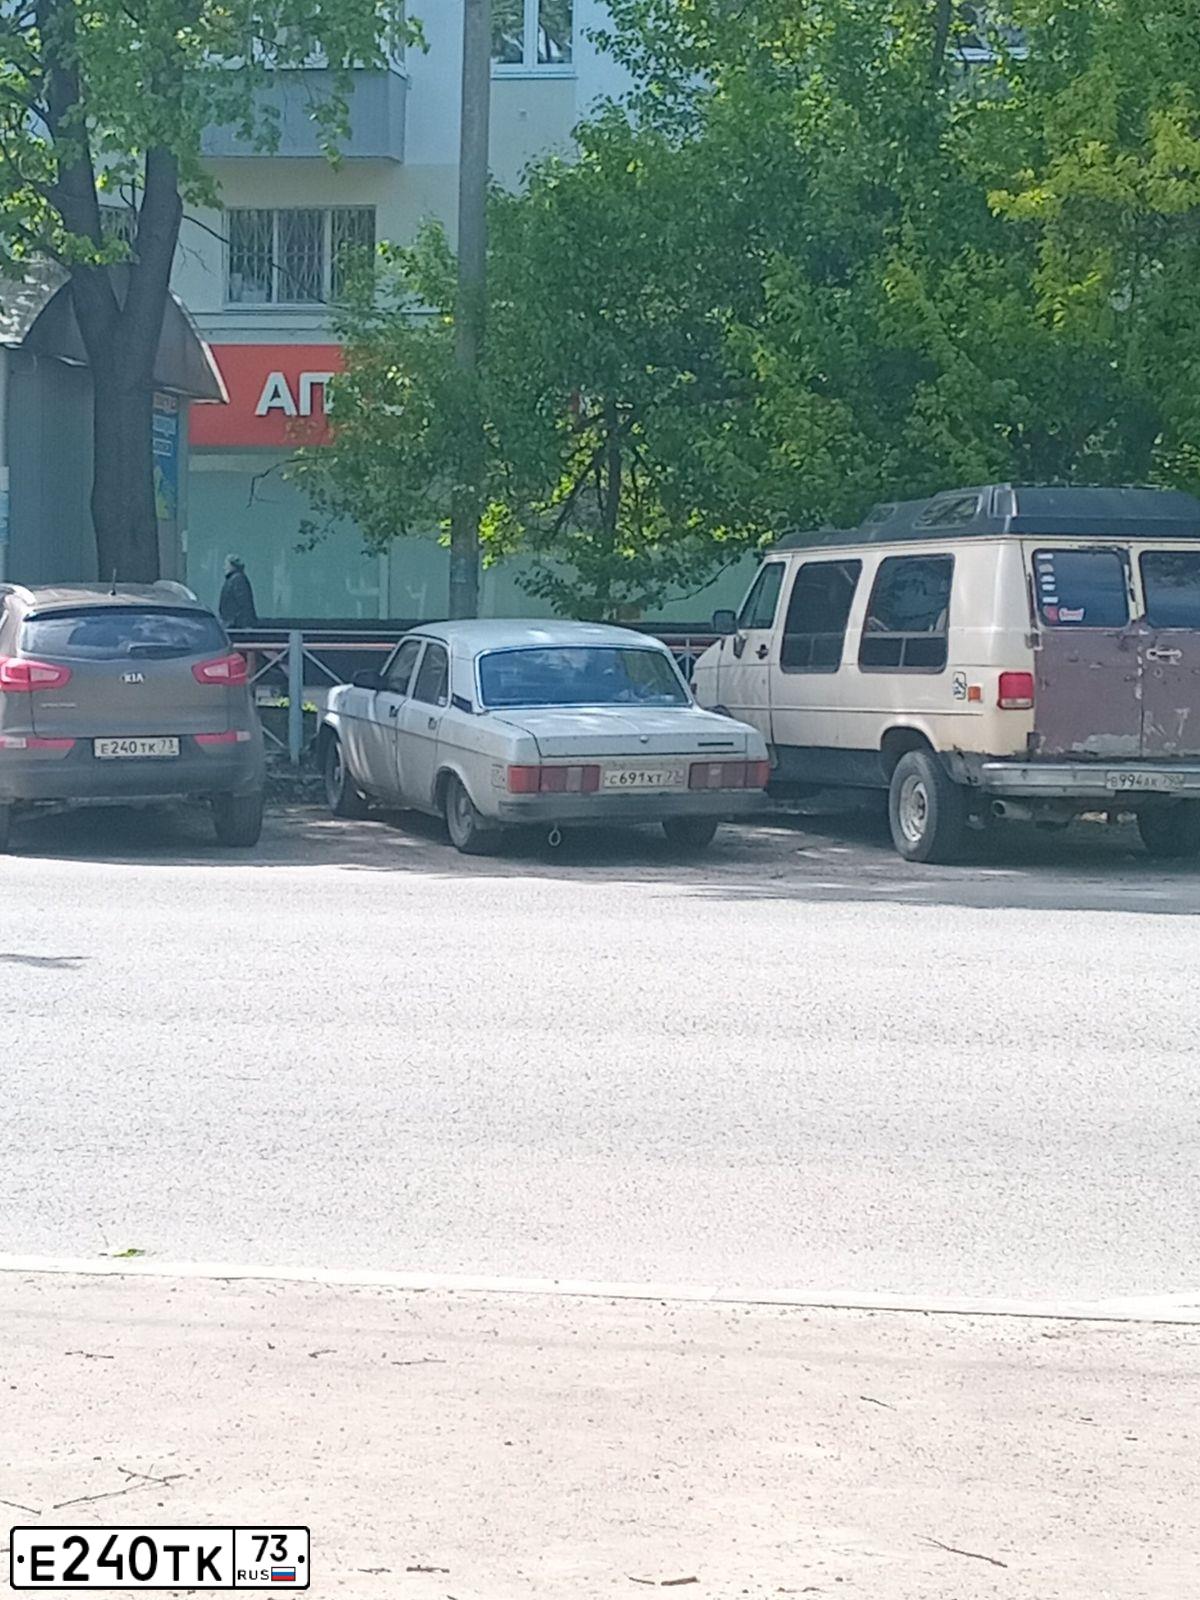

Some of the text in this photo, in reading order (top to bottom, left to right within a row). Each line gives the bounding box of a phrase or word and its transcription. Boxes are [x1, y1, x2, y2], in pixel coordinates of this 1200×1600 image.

[124, 672, 144, 684] KIA
[101, 740, 156, 755] Е240ТК
[609, 771, 661, 785] С691ХТ
